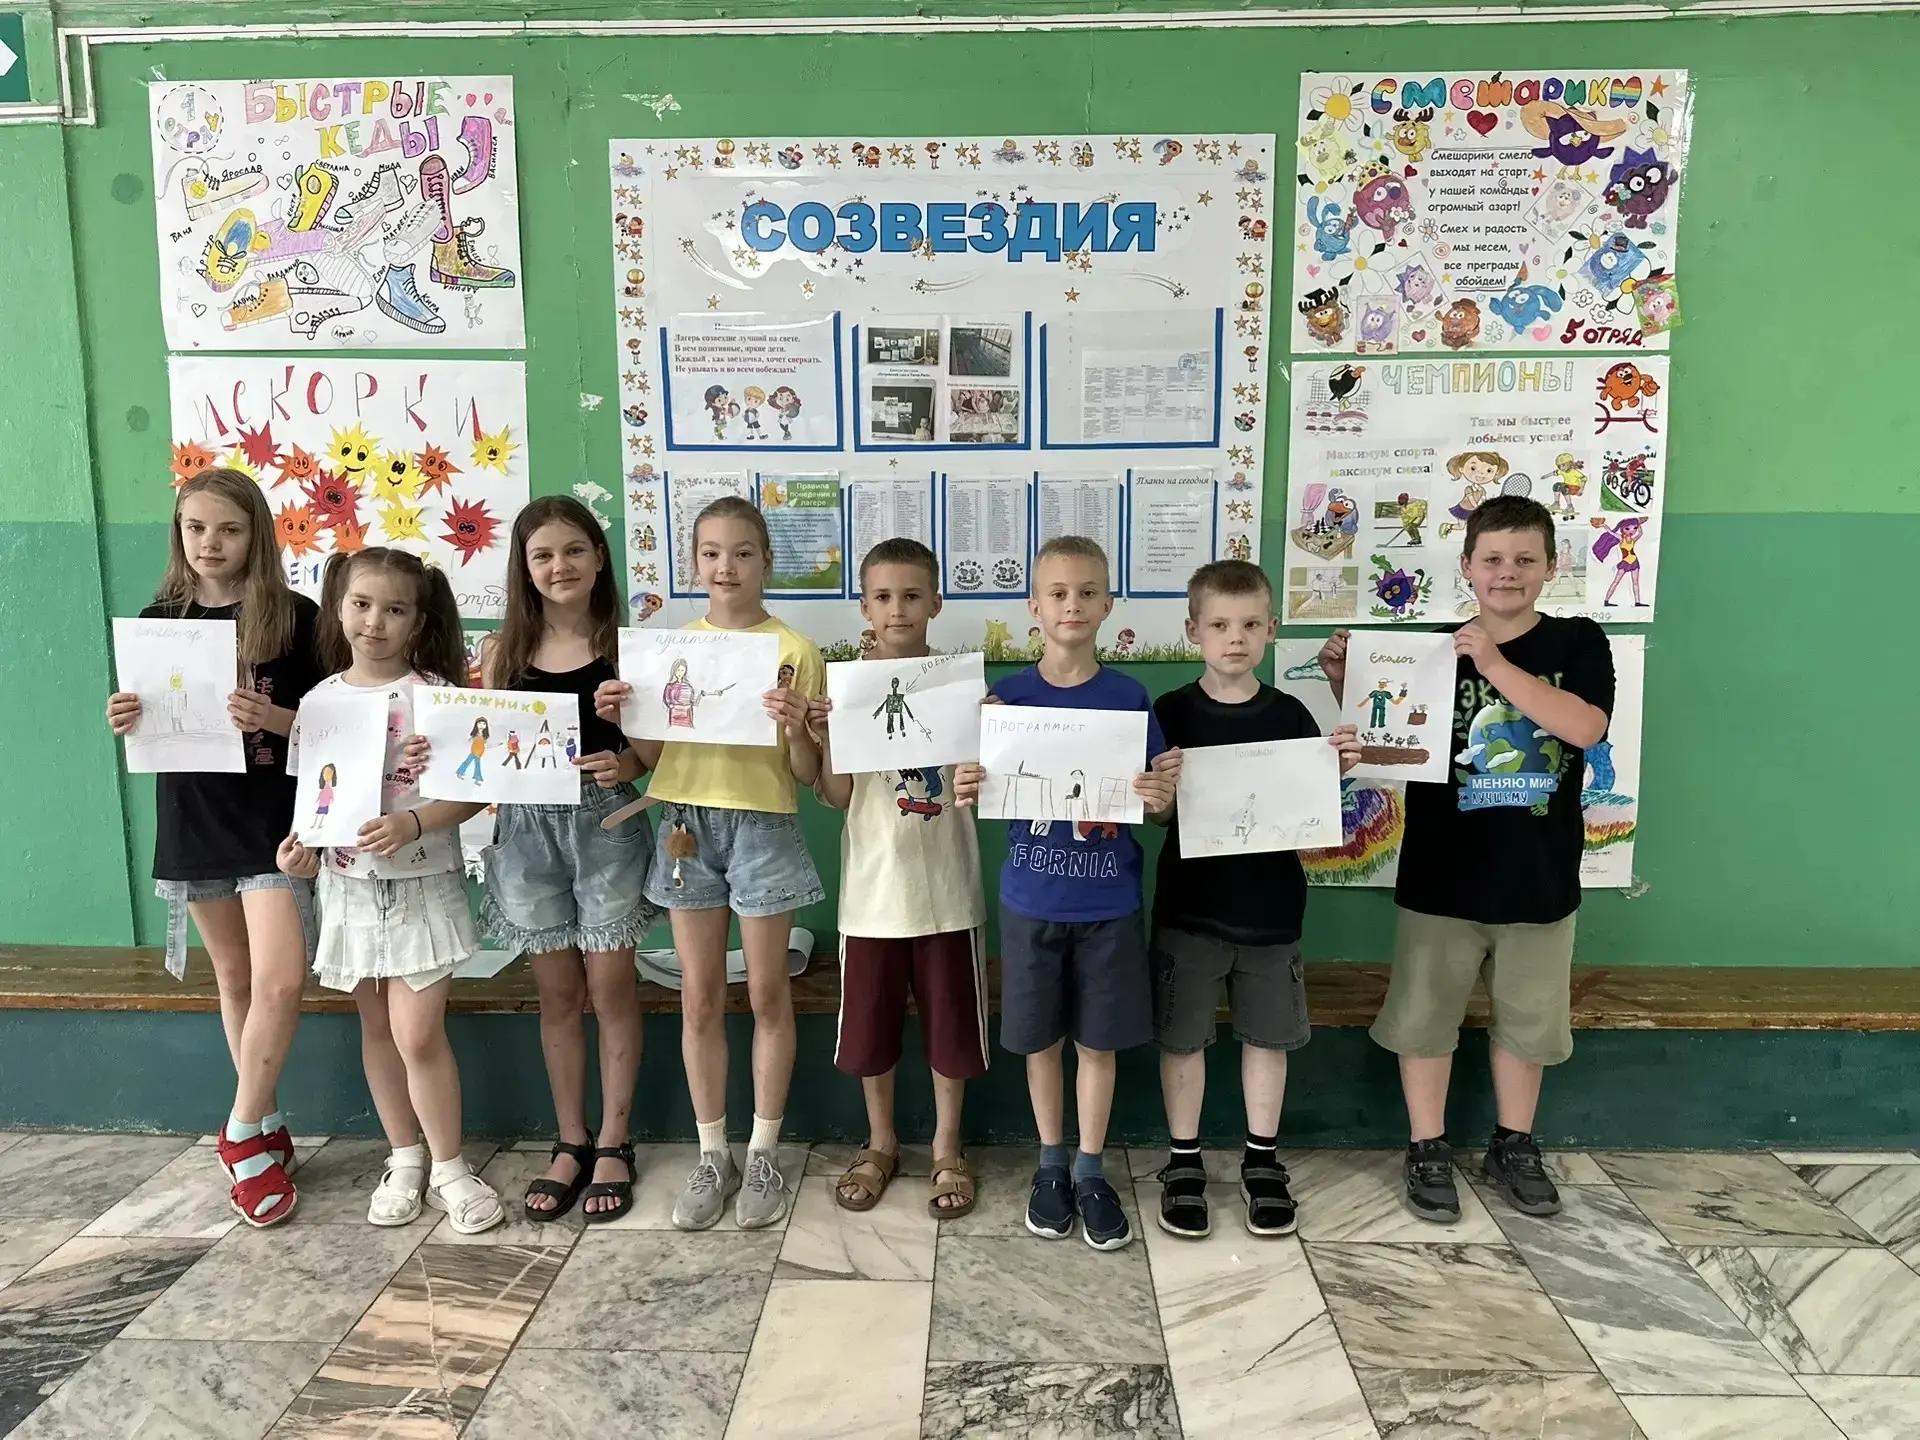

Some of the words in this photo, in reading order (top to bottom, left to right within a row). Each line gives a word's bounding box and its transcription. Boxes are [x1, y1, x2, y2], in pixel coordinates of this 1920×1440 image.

[243, 80, 453, 124] БЫСТРЫЕ
[316, 115, 440, 159] КЕДЫ
[1431, 150, 1494, 163] Смешарики
[1499, 151, 1534, 160] смело
[221, 164, 263, 182] ЯРОСЛАВ
[1430, 168, 1476, 178] выходят
[1480, 169, 1494, 177] на
[1498, 168, 1531, 179] старт,
[1429, 188, 1436, 198] у
[1440, 185, 1475, 195] нашей
[1480, 187, 1529, 197] команды
[1428, 201, 1483, 214] огромный
[1489, 200, 1521, 213] азарт!
[741, 201, 1157, 262] СОЗВЕЗДИЯ
[1440, 224, 1468, 233] Смех
[1473, 225, 1480, 233] и
[1485, 225, 1527, 236] радость
[1452, 243, 1470, 251] мы
[1475, 243, 1511, 253] несем,
[196, 234, 215, 279] АРТУР
[1444, 262, 1461, 270] все
[1467, 261, 1519, 272] преграды
[1455, 275, 1506, 286] обойдем!
[1560, 318, 1585, 344] 5
[674, 334, 701, 343] Лагерь
[1381, 360, 1574, 397] ЧЕМПИОНЫ
[193, 365, 483, 442] ИСКОРКИ
[1497, 417, 1516, 426] мы
[1520, 416, 1571, 427] быстрее
[1467, 432, 1526, 445] добьёмся
[1530, 429, 1574, 443] успеха!
[1327, 449, 1390, 461] Максимум
[1330, 466, 1392, 477] максимум
[1396, 462, 1434, 474] смеха!
[796, 482, 830, 490] Правила
[1136, 476, 1165, 485] Планы
[1167, 477, 1178, 485] на
[1180, 477, 1209, 486] сегодня
[432, 692, 531, 711] ХУДОЖНИК
[1472, 778, 1525, 789] МЕНЯЮ
[1529, 778, 1553, 788] МИР
[1472, 791, 1528, 804] ЛУЧШЕМУ
